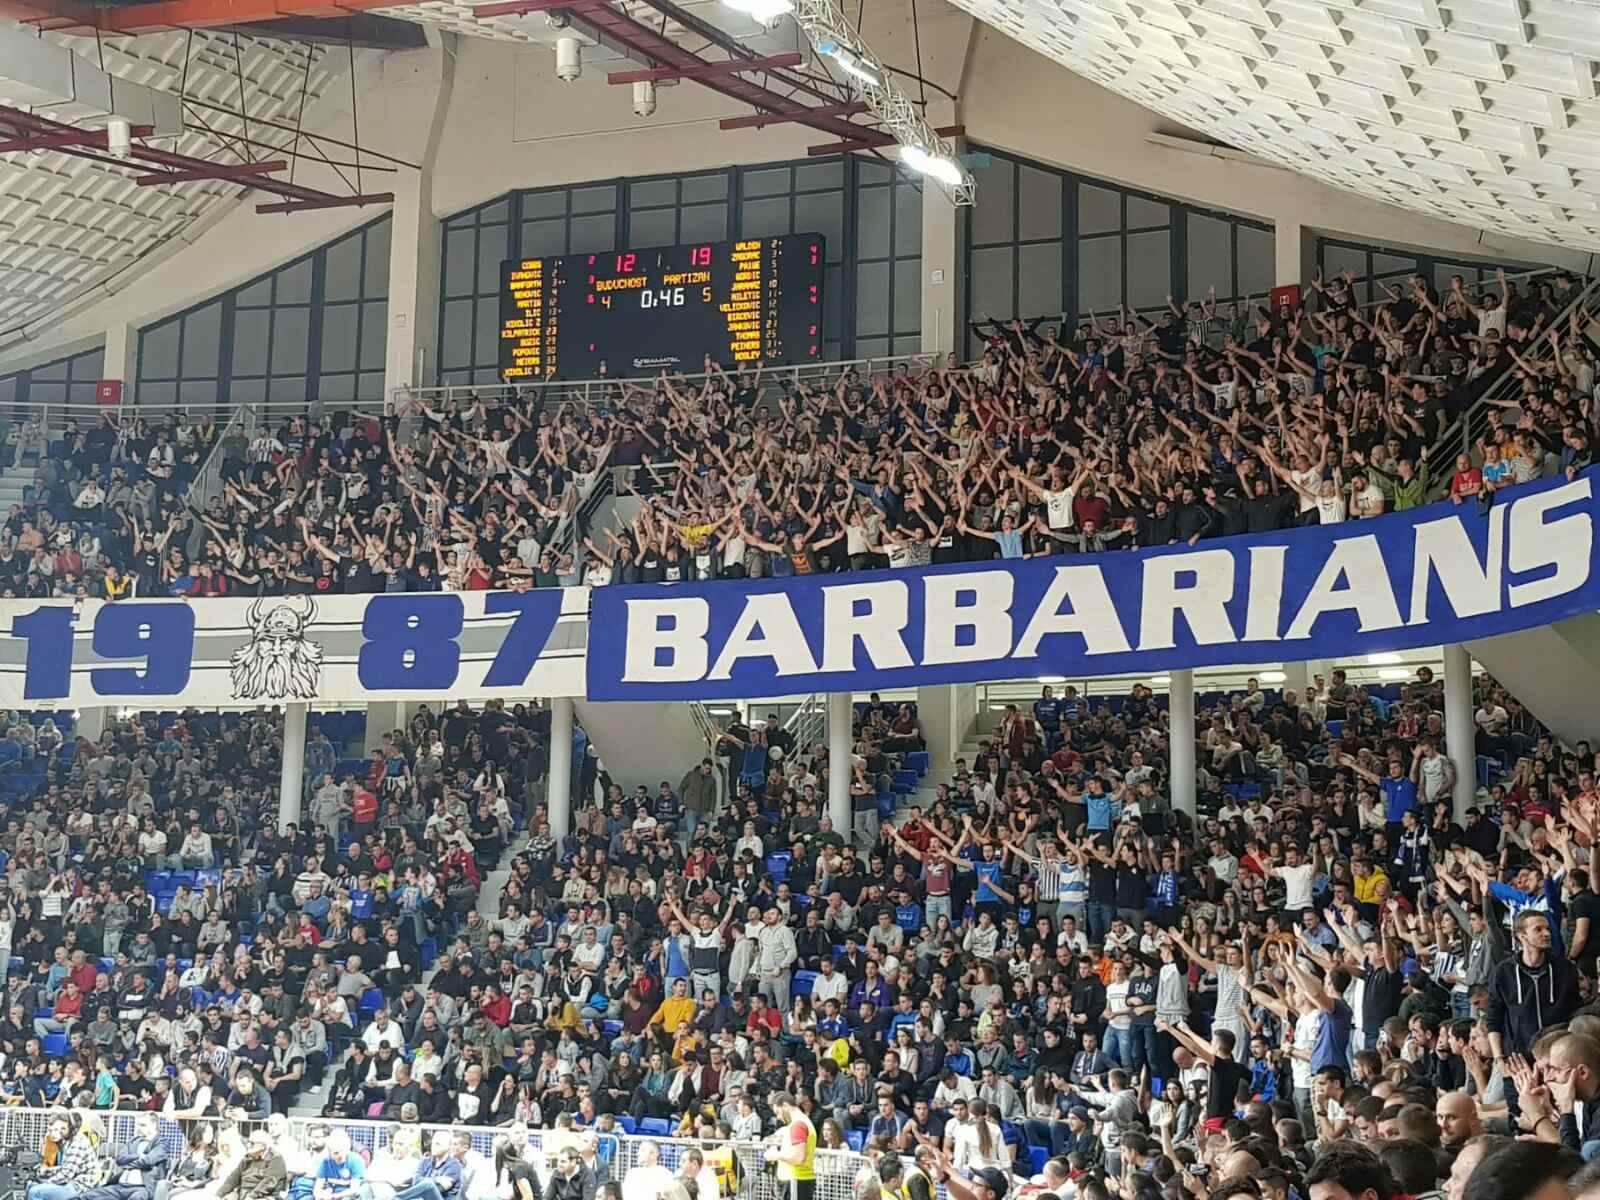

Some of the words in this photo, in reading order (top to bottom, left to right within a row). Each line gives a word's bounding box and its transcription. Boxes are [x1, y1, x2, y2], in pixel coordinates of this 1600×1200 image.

[616, 254, 636, 273] 12
[691, 247, 711, 266] 19
[664, 271, 710, 285] PARTIZAN
[602, 296, 611, 309] 4
[703, 287, 711, 302] 5
[621, 478, 1593, 683] BARBARIANS
